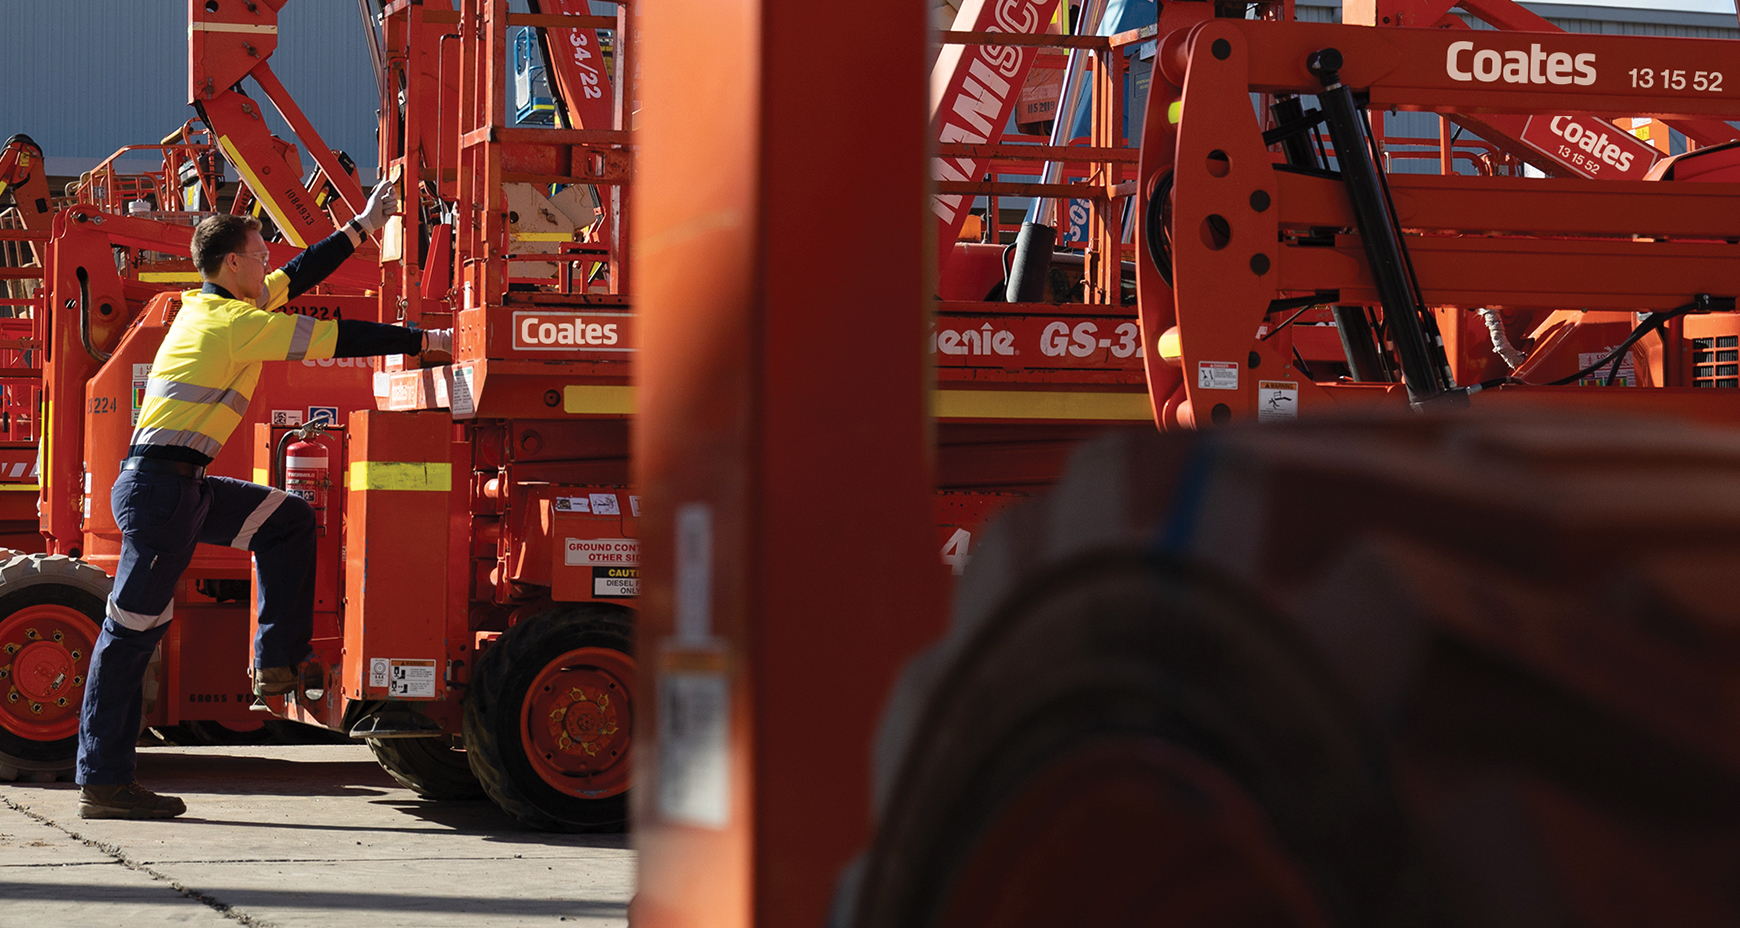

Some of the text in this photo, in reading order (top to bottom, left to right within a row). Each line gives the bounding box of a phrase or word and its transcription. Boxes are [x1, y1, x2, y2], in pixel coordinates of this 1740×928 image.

[1446, 40, 1597, 86] Coates
[1628, 68, 1723, 92] 13 15 52
[1550, 116, 1635, 172] Coates
[1558, 145, 1600, 175] 13 15 52
[285, 189, 315, 226] 1084933
[521, 318, 618, 345] Coates
[1039, 321, 1145, 358] GS-3
[569, 543, 612, 551] GROUND
[588, 553, 623, 562] OTHER
[189, 694, 228, 703] GROSS
